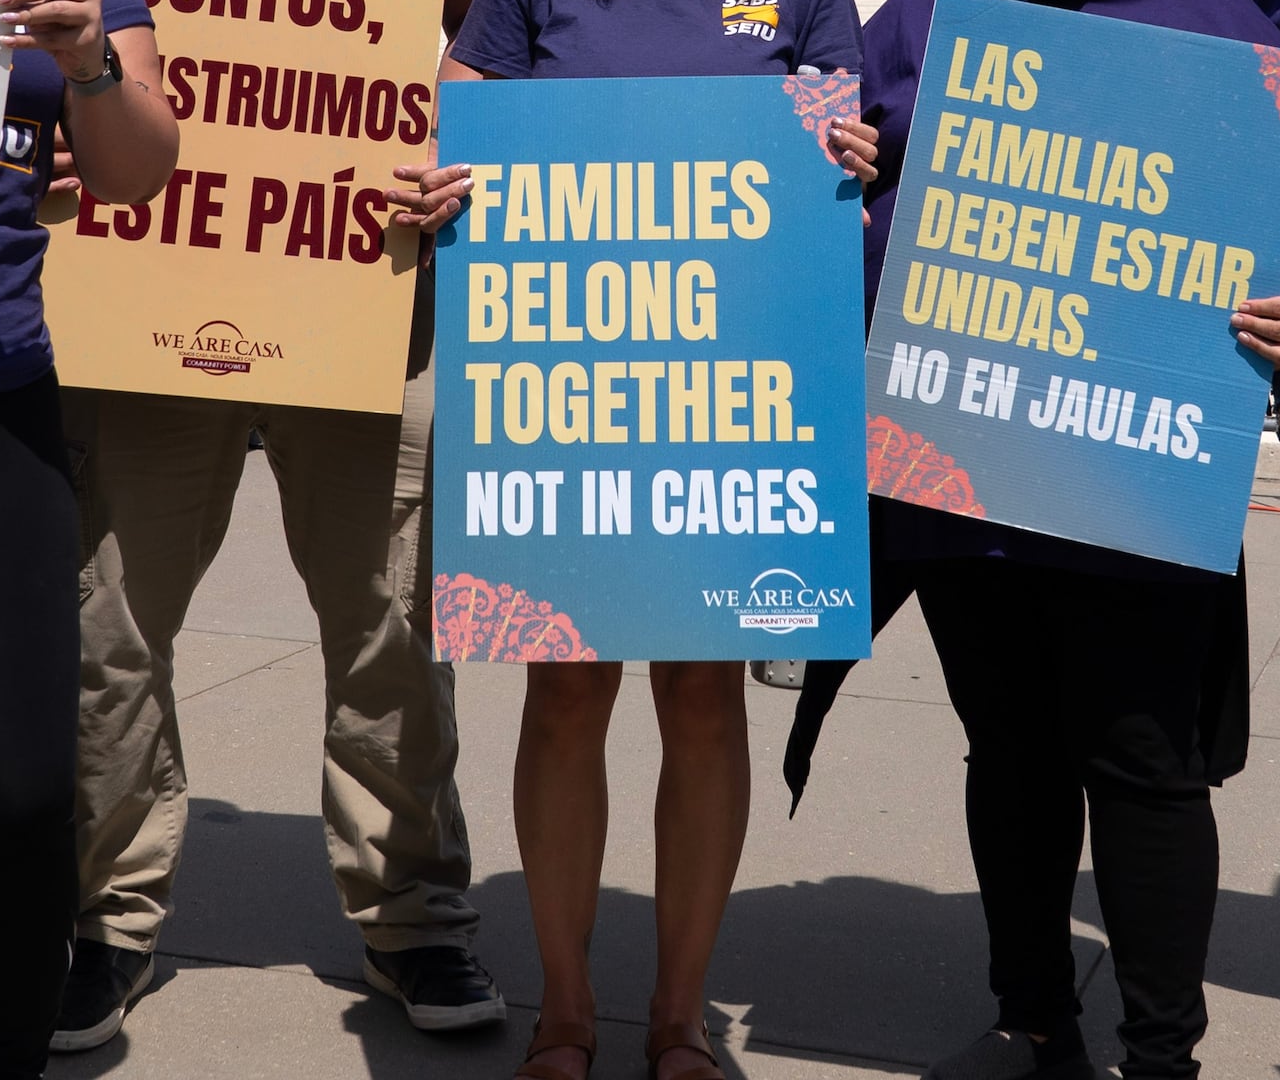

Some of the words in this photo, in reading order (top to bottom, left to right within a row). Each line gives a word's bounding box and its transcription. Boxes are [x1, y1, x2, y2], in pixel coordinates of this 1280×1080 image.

[724, 23, 776, 42] SEIU
[945, 37, 1043, 111] LAS
[468, 159, 771, 243] FAMILIES
[930, 111, 1174, 216] FAMILIAS
[915, 186, 1081, 278] DEBEN
[1091, 221, 1256, 311] ESTAR
[467, 259, 717, 342] BELONG
[902, 261, 1098, 362] UNIDAS.
[152, 332, 184, 349] WE
[190, 336, 231, 353] ARE
[235, 340, 285, 359] CASA
[186, 359, 223, 369] COMMUNITY
[224, 363, 247, 371] POWER
[465, 360, 815, 445] TOGETHER.
[886, 341, 949, 405] NO
[958, 357, 1020, 422] EN
[1028, 376, 1212, 465] JAULAS.
[465, 470, 564, 537] NOT
[581, 470, 632, 536] IN
[651, 468, 835, 534] CAGES.
[701, 589, 739, 608] WE
[746, 589, 793, 607] ARE
[797, 588, 856, 608] CASA
[745, 617, 787, 625] COMMUNITY
[788, 617, 814, 625] POWER
